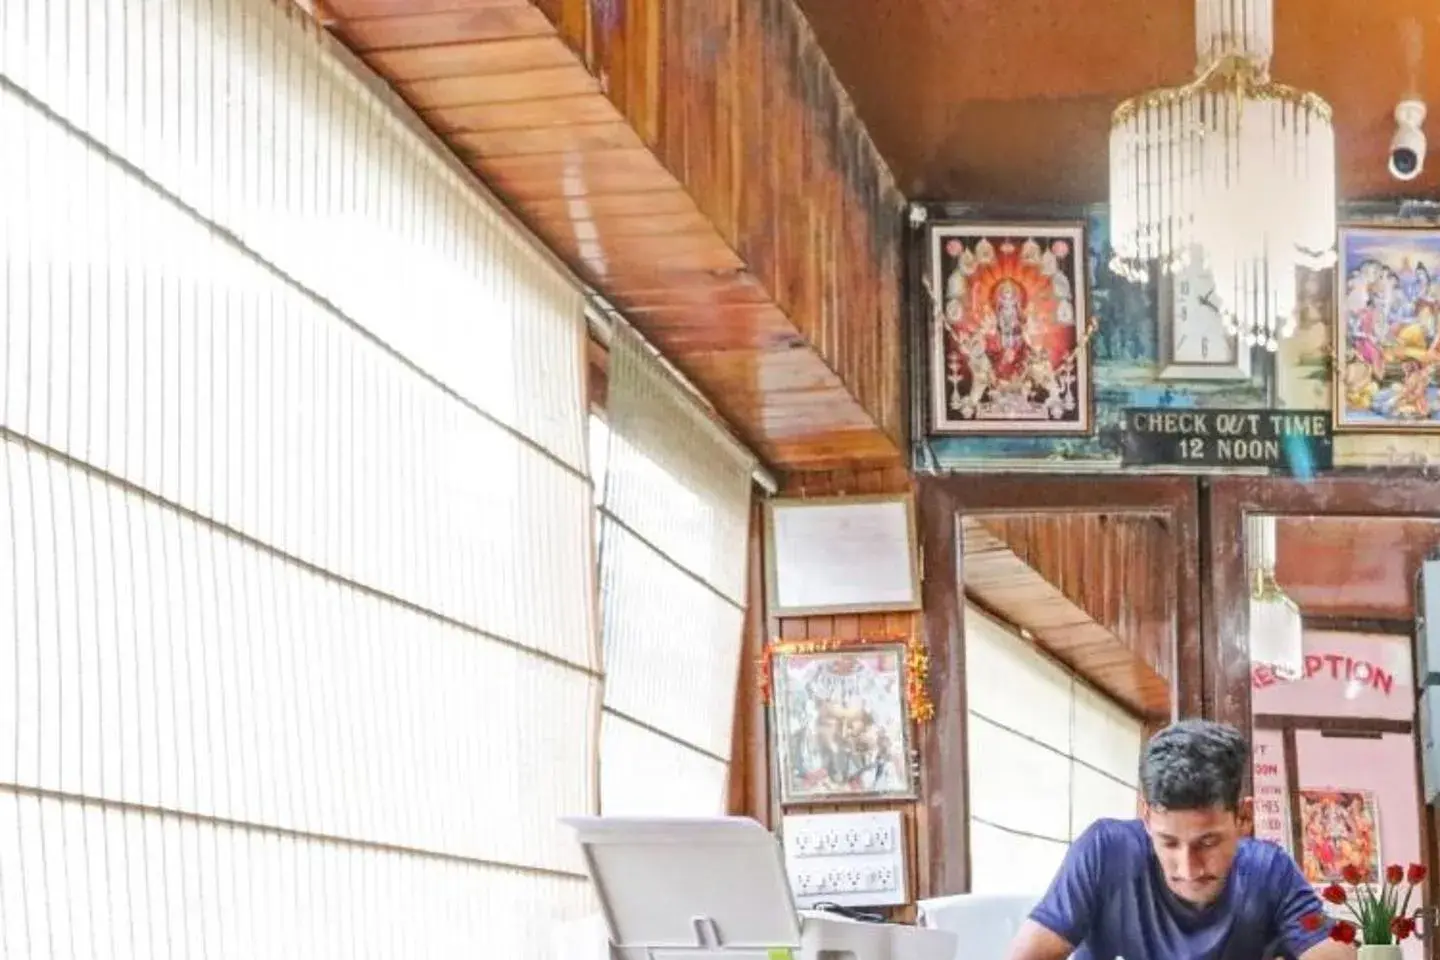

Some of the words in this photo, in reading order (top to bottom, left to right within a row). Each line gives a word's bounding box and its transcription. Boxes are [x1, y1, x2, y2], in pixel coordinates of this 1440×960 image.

[1134, 412, 1209, 435] CHECK
[1216, 413, 1260, 435] OUT
[1270, 414, 1326, 437] TIME
[1178, 438, 1205, 459] 12
[1216, 439, 1279, 460] NOON
